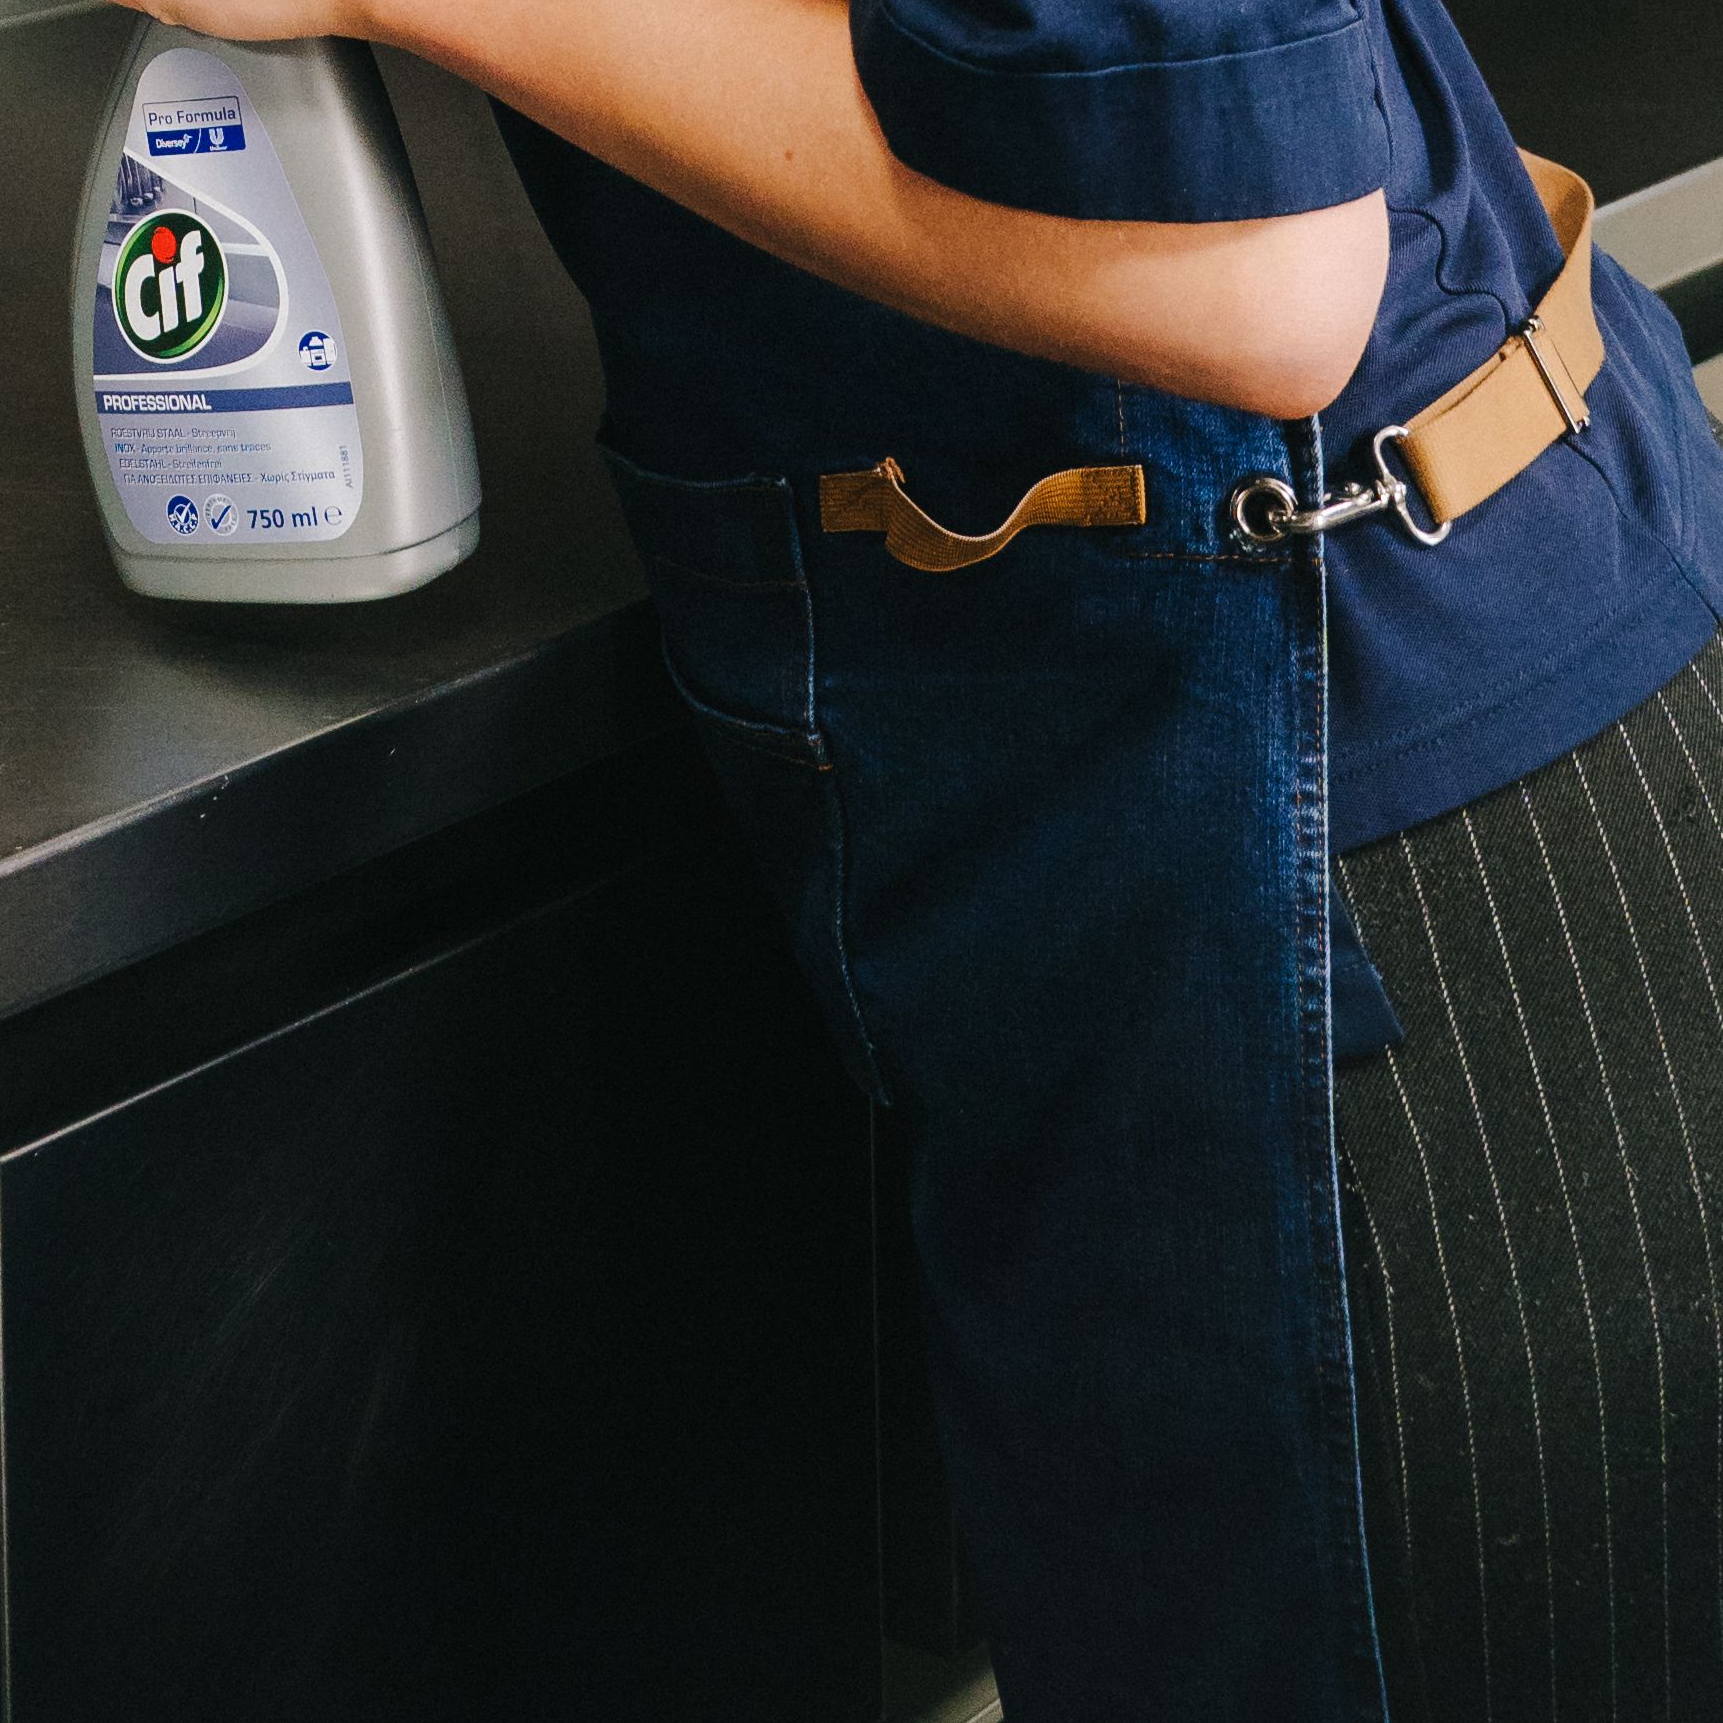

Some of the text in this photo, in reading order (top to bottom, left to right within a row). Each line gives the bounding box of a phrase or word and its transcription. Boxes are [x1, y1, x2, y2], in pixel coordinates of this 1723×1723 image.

[148, 106, 237, 126] Pro Formula
[103, 394, 212, 413] PROFESSIONAL
[156, 427, 186, 438] STAAL
[115, 442, 135, 453] INOX
[247, 508, 285, 529] 750
[291, 506, 319, 528] ml
